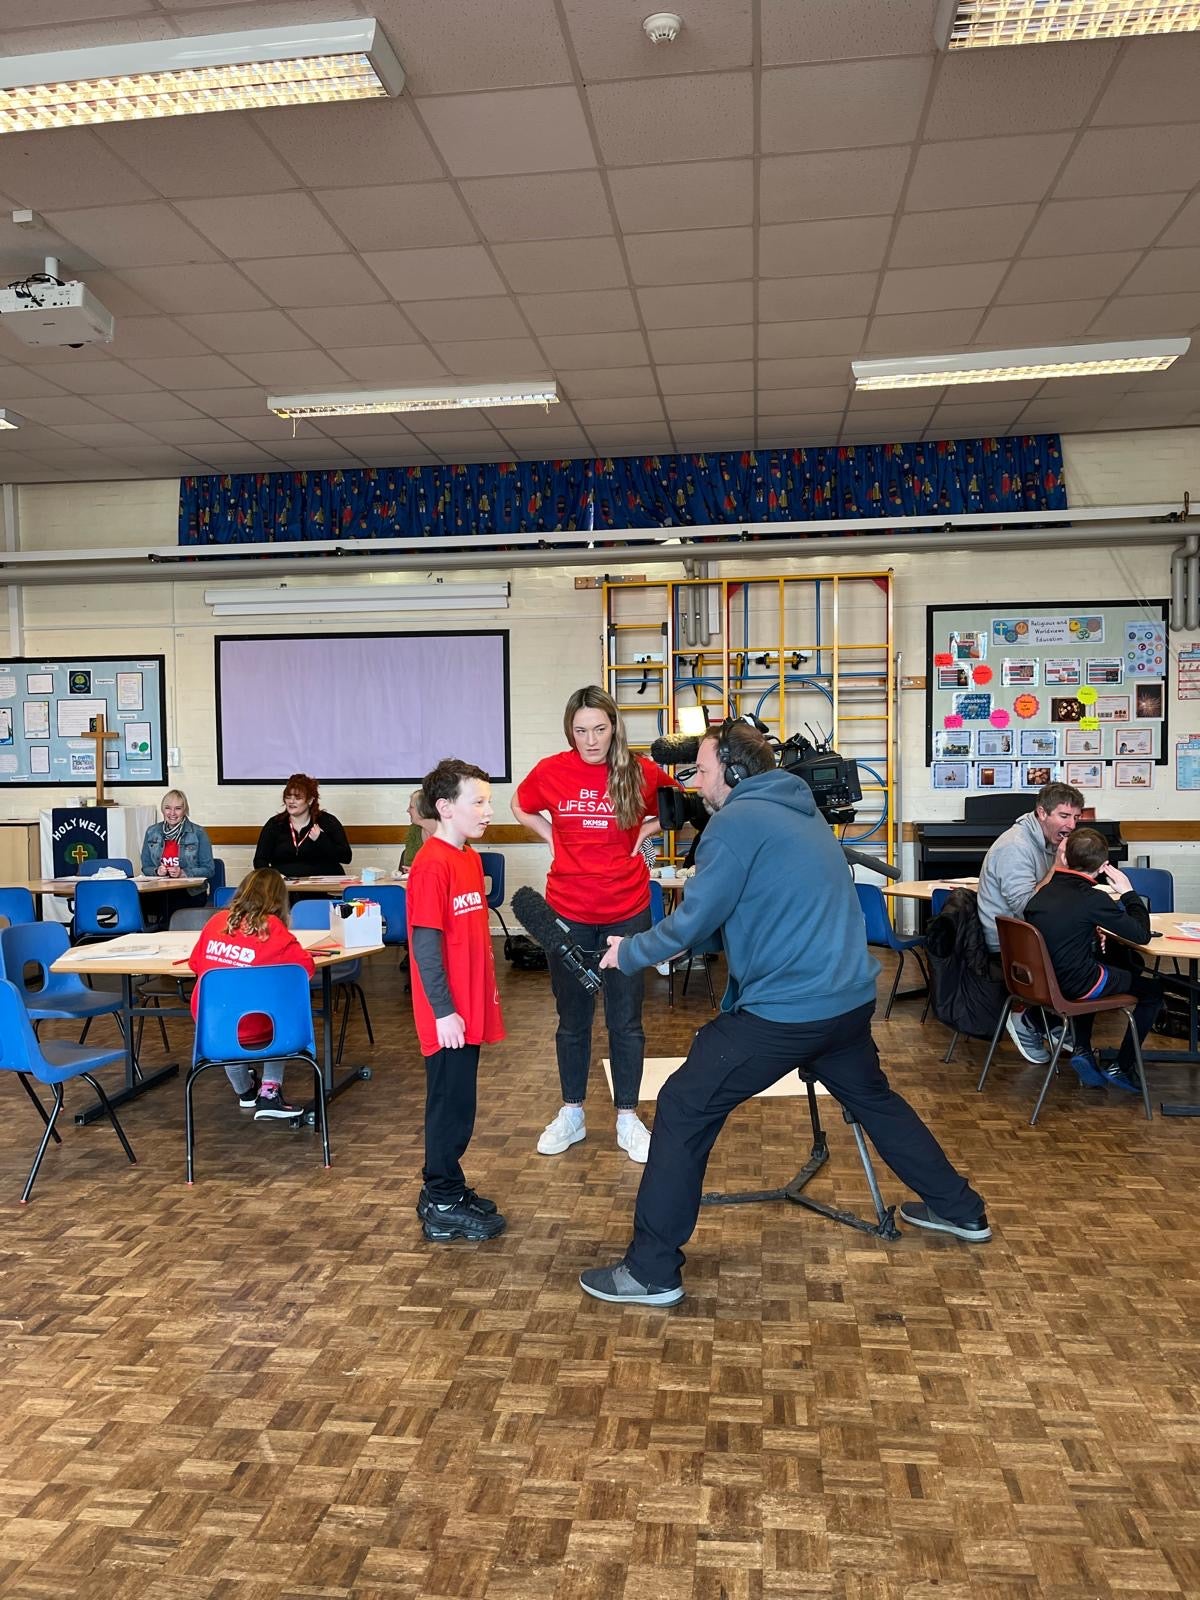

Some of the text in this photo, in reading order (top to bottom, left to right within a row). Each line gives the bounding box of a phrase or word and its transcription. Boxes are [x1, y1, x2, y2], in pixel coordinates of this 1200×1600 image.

[580, 788, 599, 799] BE
[558, 800, 616, 813] LIFESAV
[52, 817, 107, 841] HOLYWELL
[162, 857, 180, 866] MS
[205, 940, 242, 960] DKMS
